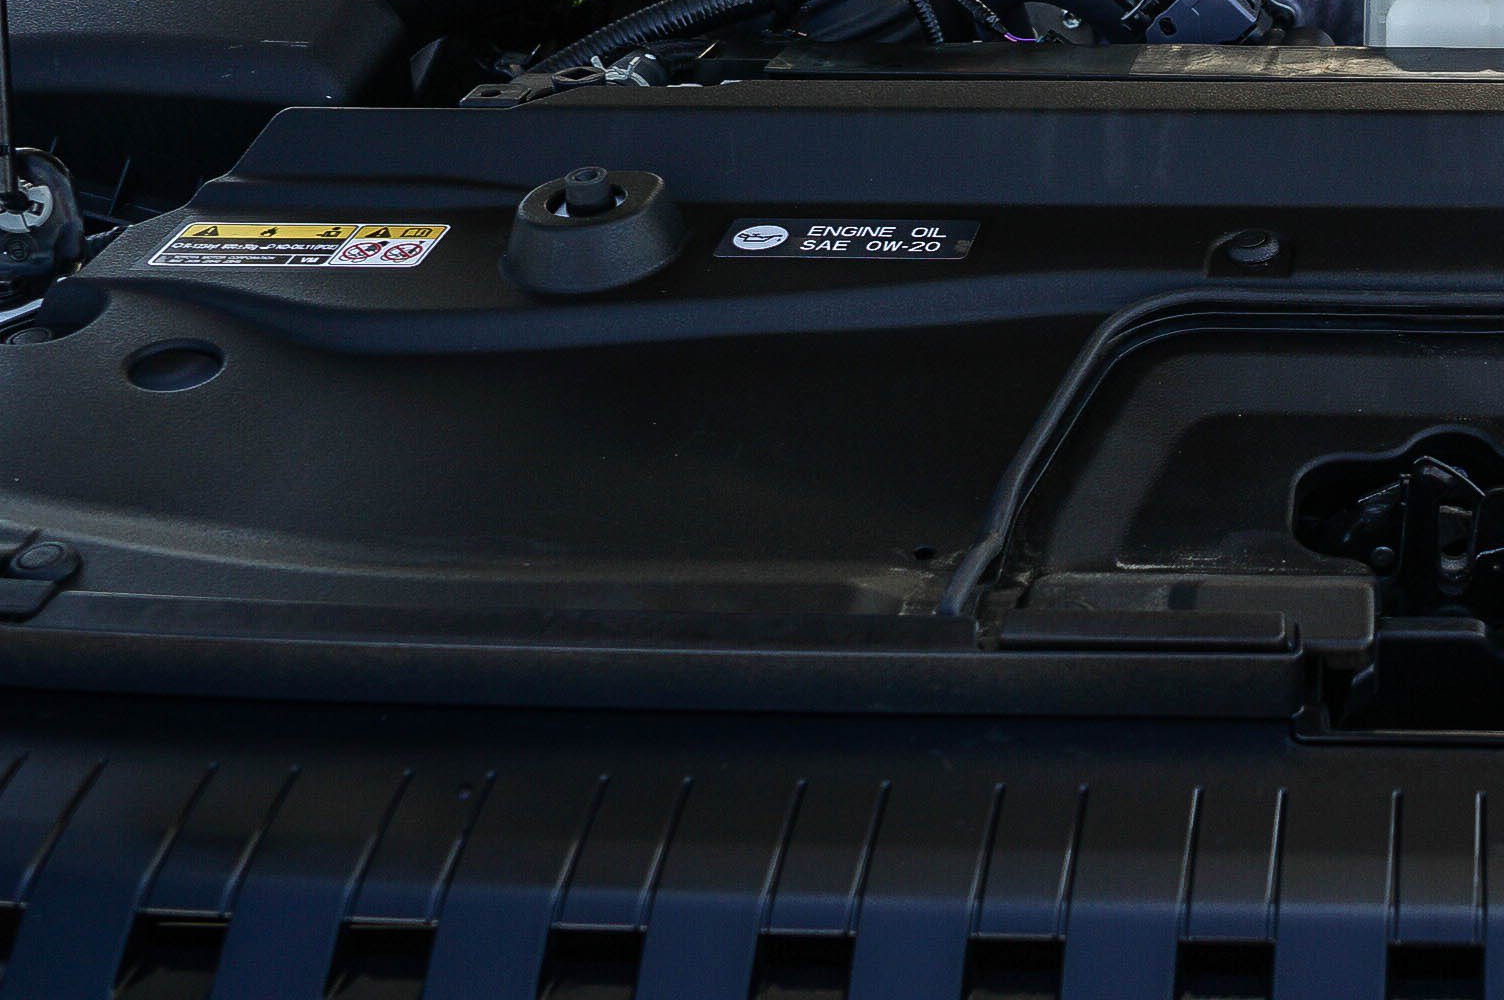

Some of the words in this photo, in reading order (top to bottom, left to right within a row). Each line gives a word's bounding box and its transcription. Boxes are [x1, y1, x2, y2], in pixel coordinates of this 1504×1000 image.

[807, 225, 897, 237] ENGINE
[910, 227, 947, 238] OIL
[799, 239, 852, 251] SAE
[865, 240, 941, 252] 0W-20
